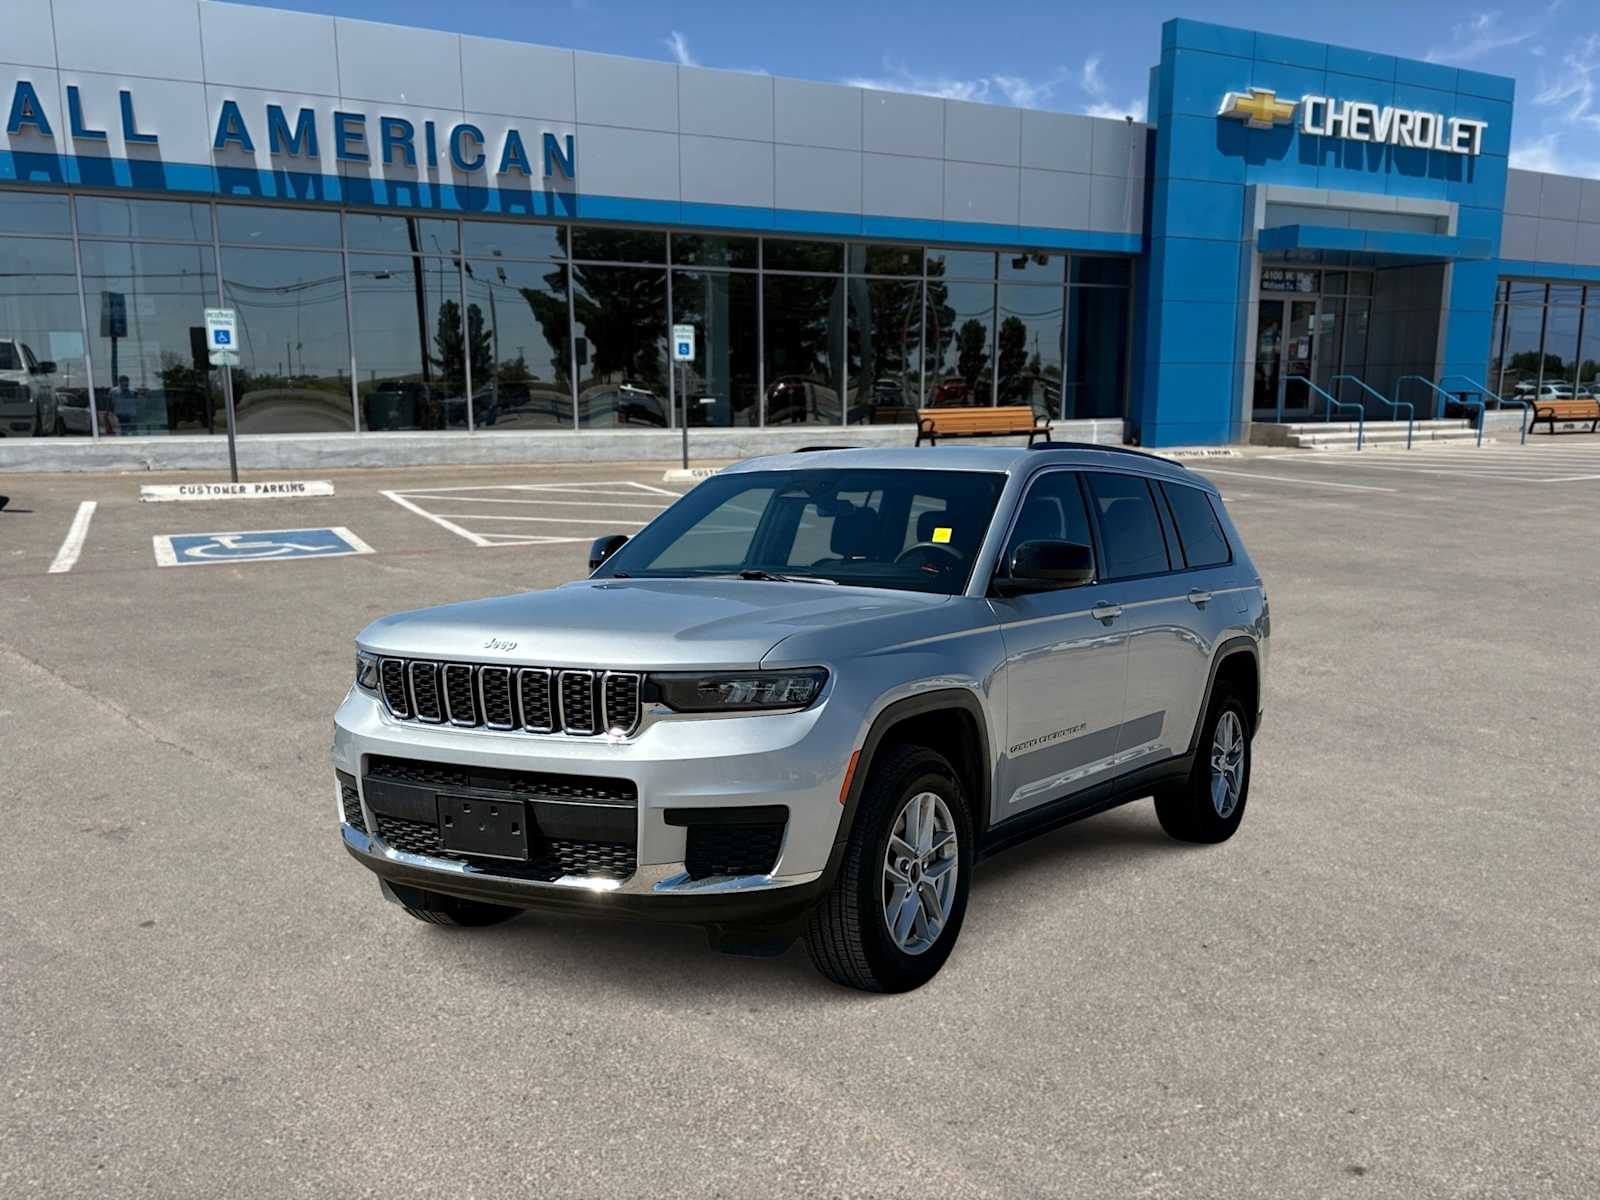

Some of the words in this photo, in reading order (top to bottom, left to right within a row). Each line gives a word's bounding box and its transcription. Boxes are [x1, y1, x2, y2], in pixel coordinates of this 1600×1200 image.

[7, 80, 159, 144] ALL
[213, 99, 576, 179] AMERICAN
[1301, 94, 1489, 156] CHEVROLET
[179, 485, 247, 495] CUSTOMER
[254, 483, 306, 494] PARKING
[483, 636, 518, 652] Jeep
